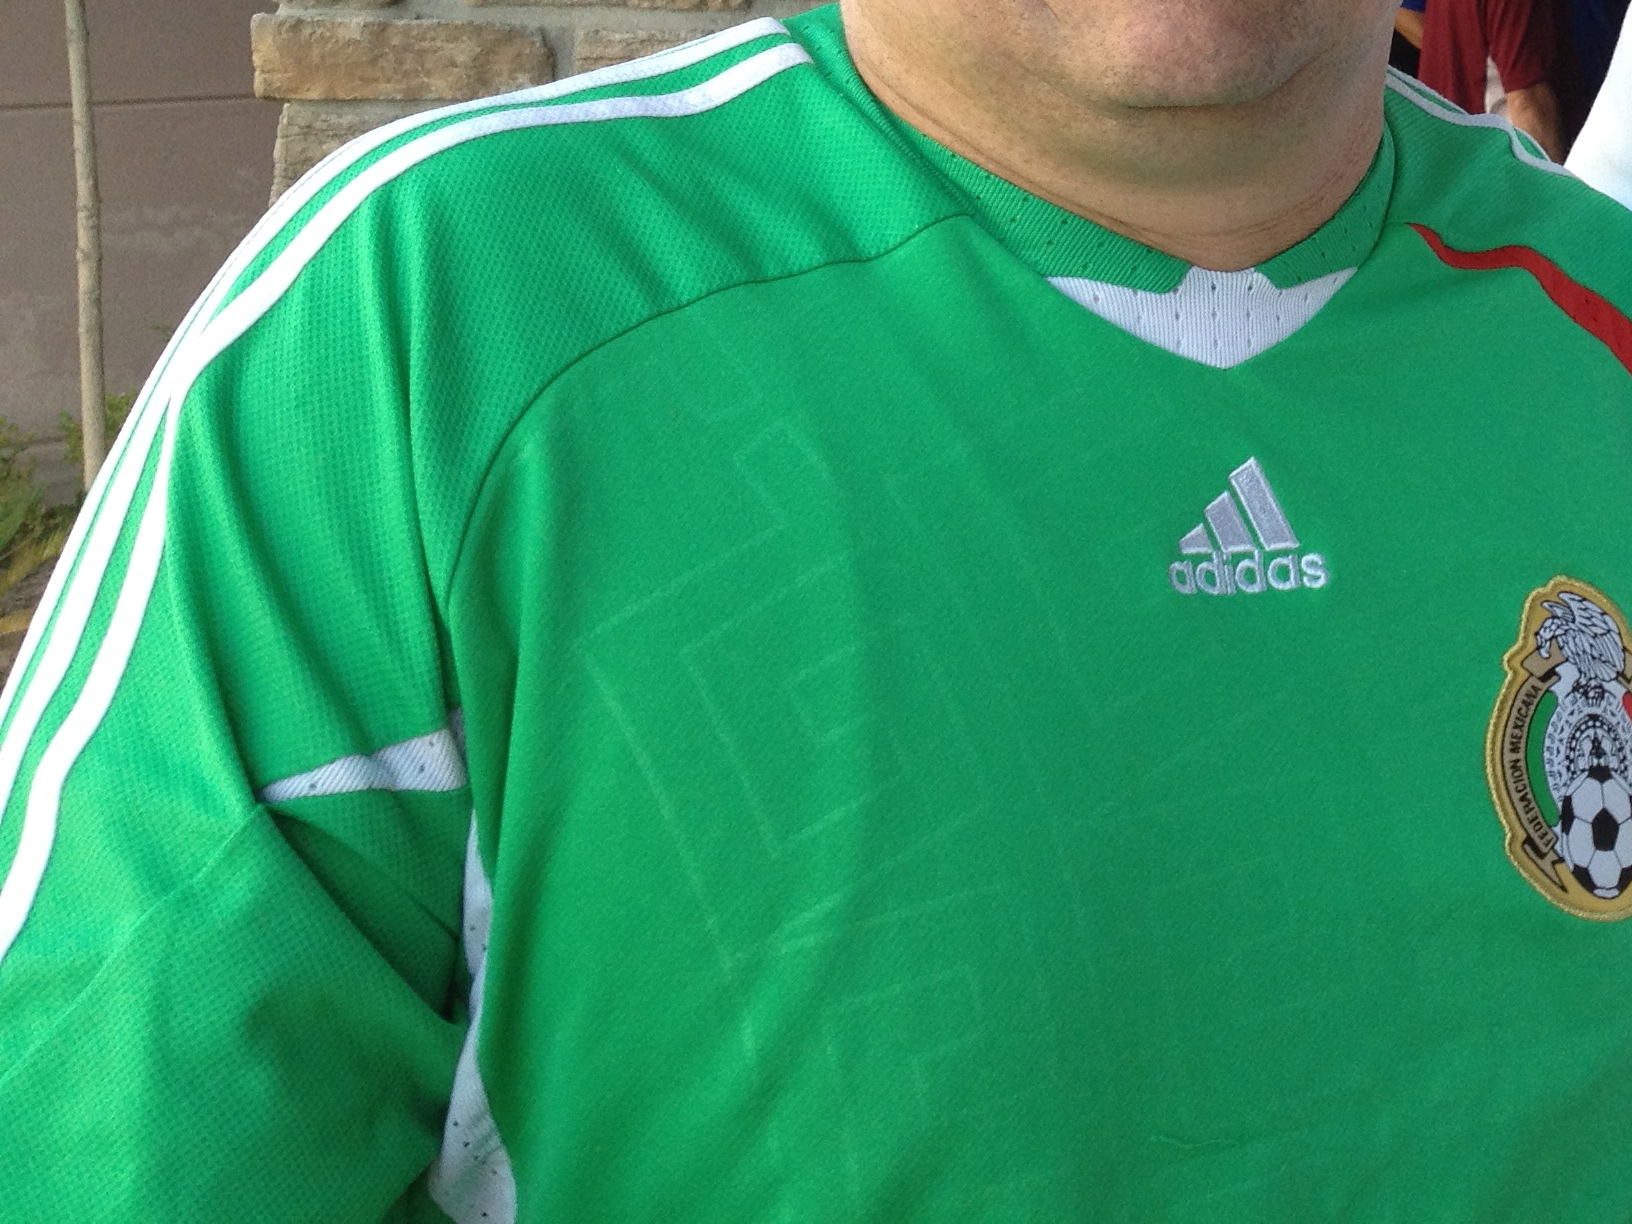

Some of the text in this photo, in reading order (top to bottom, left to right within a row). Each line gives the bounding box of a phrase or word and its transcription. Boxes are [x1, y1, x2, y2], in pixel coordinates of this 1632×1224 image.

[1168, 549, 1329, 595] adidas
[1508, 684, 1555, 848] FEDERACION MEXICANA
